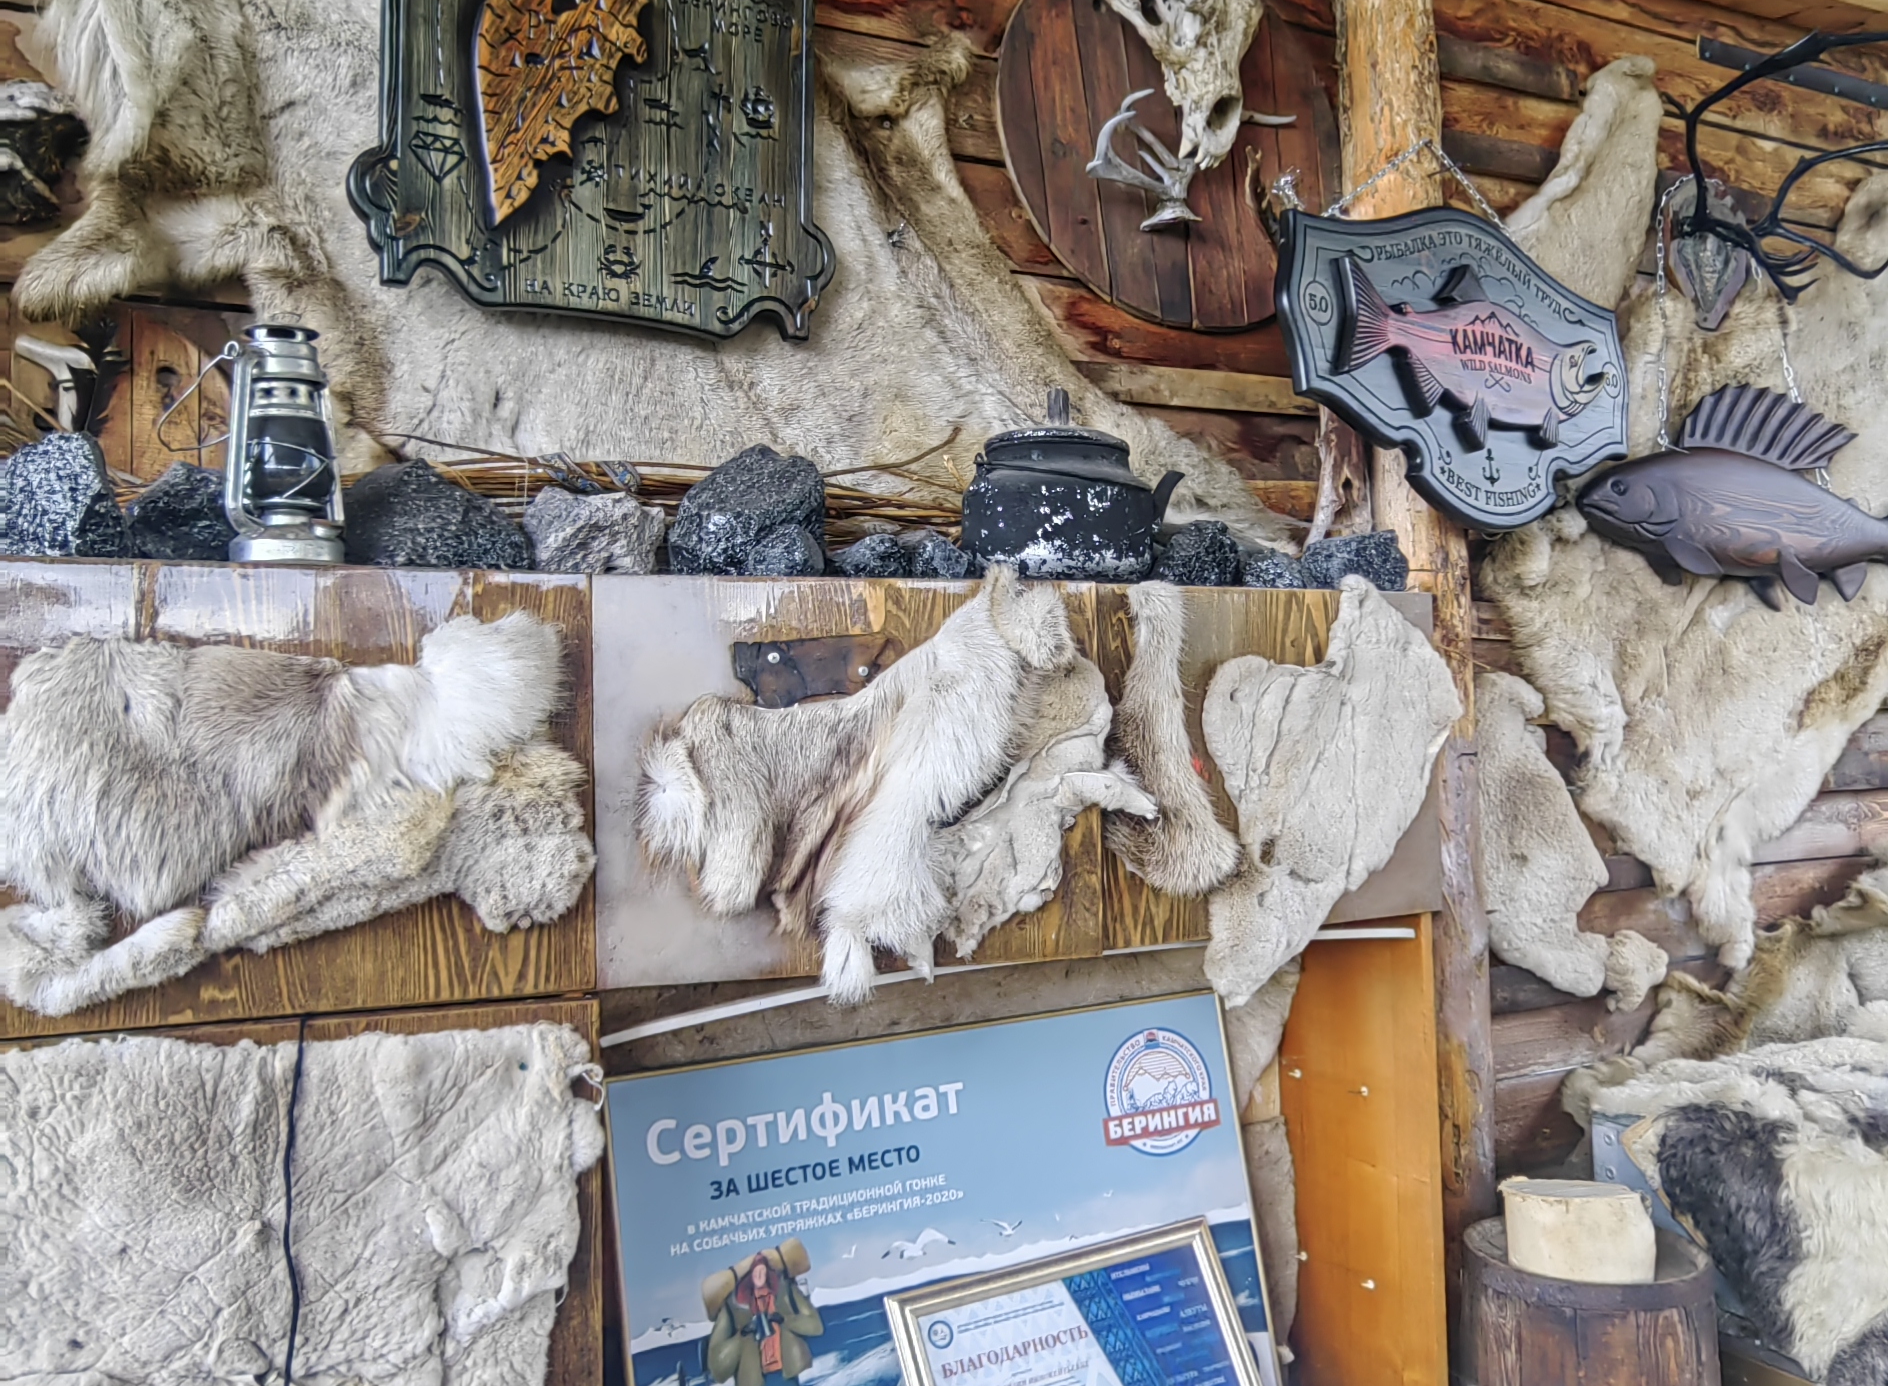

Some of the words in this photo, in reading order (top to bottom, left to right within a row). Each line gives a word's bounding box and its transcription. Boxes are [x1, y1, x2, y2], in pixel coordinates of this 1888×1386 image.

[714, 17, 763, 43] МОРЕ
[714, 182, 786, 208] ОКЕАН
[525, 278, 552, 296] НА
[562, 281, 620, 303] КРАЮ
[630, 291, 696, 317] ЗЕМЛИ
[1376, 232, 1438, 261] РЫБАЛКА
[1438, 231, 1463, 247] ЭТО
[1534, 283, 1564, 319] ТРУД
[1449, 328, 1536, 373] КАМЧАТКА
[1460, 358, 1487, 372] WILD
[1488, 361, 1533, 385] SALMONS
[1446, 467, 1482, 502] BEST
[1484, 481, 1537, 507] FISHING
[646, 1081, 964, 1167] Сертификат
[1108, 1102, 1217, 1140] БЕРИНГИЯ
[709, 1179, 740, 1200] ЗА
[747, 1159, 842, 1195] ШЕСТОЕ
[848, 1145, 921, 1175] МЕСТО
[670, 1243, 690, 1257] НА
[693, 1225, 768, 1251] СОБАЧЬИХ
[769, 1211, 844, 1239] УПРЯЖКАХ
[846, 1189, 965, 1221] «БЕРИНГИЯ-2020»
[699, 1202, 792, 1233] КАМЧАТСКОЙ
[794, 1179, 904, 1214] ТРАДИЦИОННОЙ
[905, 1174, 948, 1195] ГОНКЕ
[941, 1324, 1089, 1380] БЛАГОДАРНОСТЬ
